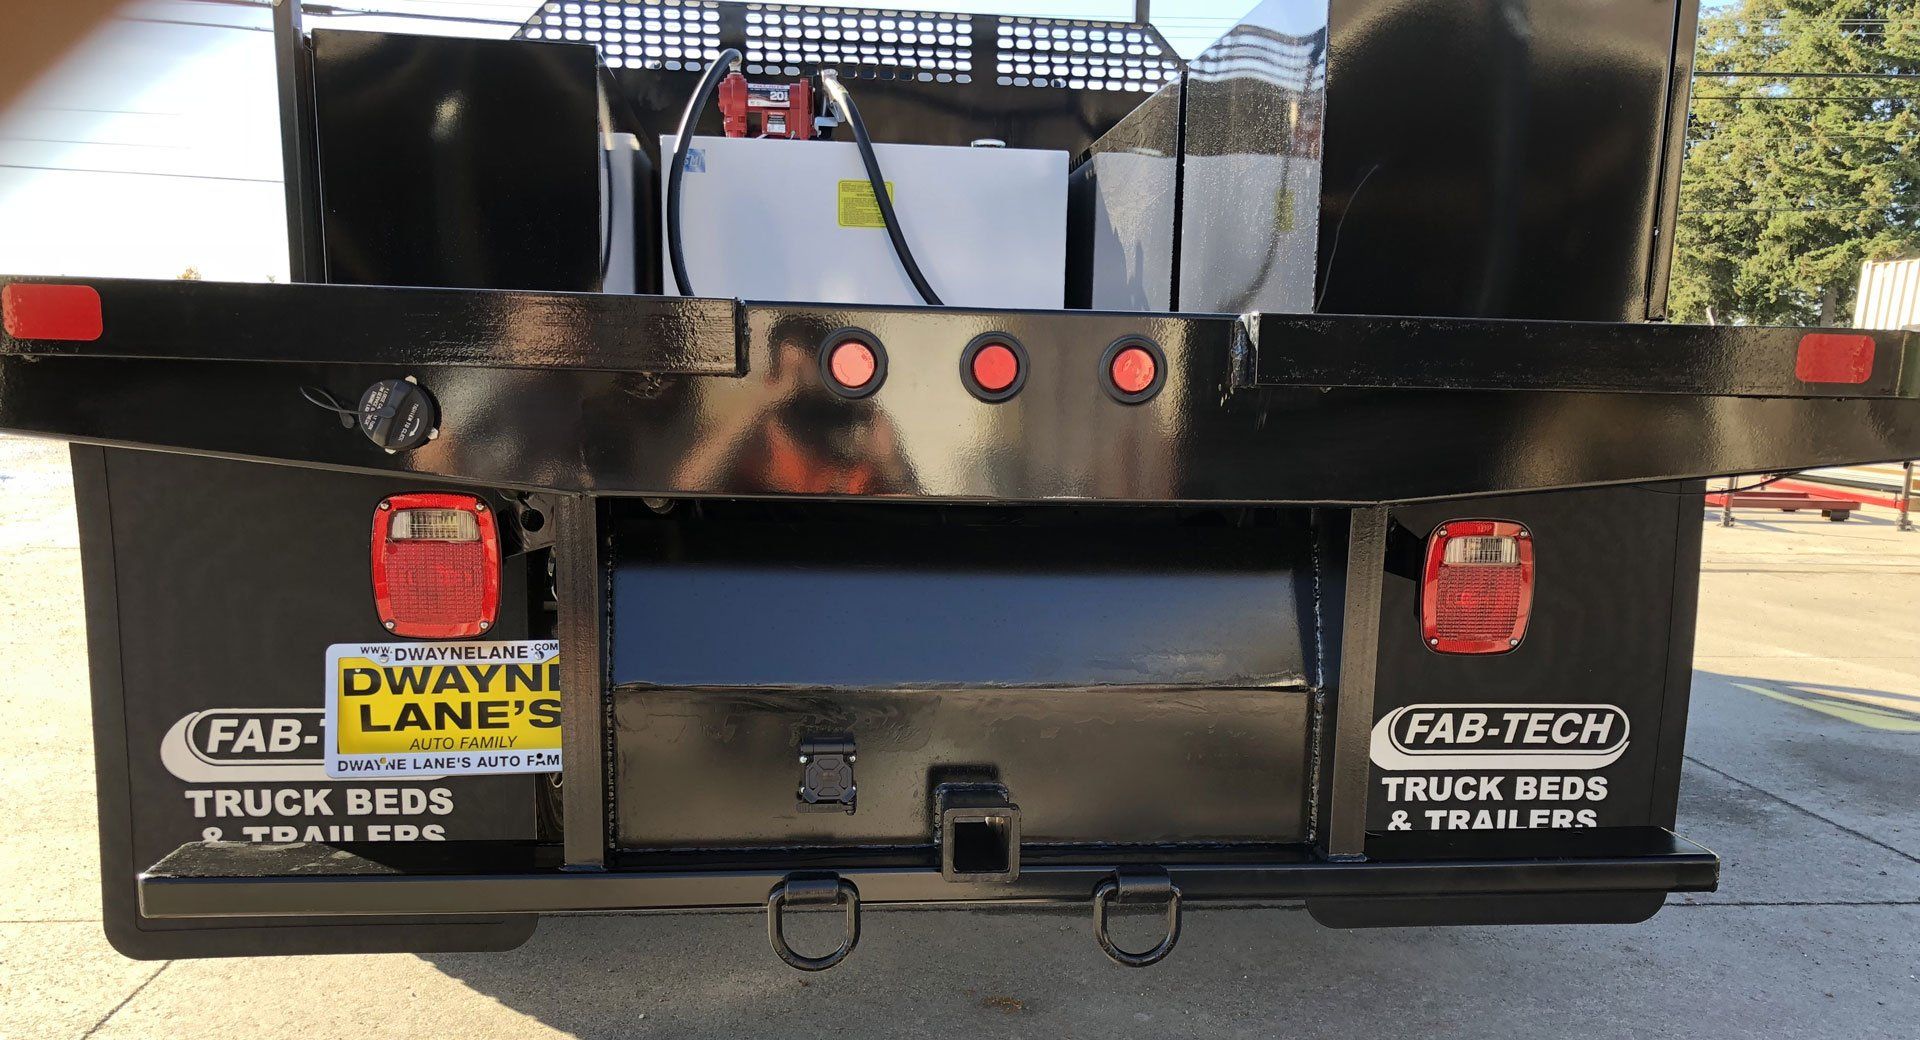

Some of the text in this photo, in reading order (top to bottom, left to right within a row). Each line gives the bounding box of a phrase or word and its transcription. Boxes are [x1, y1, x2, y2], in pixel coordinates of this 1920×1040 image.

[360, 698, 561, 732] LANE'S
[1404, 712, 1615, 744] FAB-TECH
[206, 718, 325, 754] FAB-
[409, 736, 518, 750] AUTO FAMILY
[337, 758, 407, 772] DWAYNE
[413, 757, 471, 770] LANE'S
[477, 756, 521, 768] AUTO
[184, 787, 454, 817] TRUCK BEDS
[1381, 775, 1608, 801] TRUCK BEDS
[1387, 808, 1598, 831] & TRAILERS
